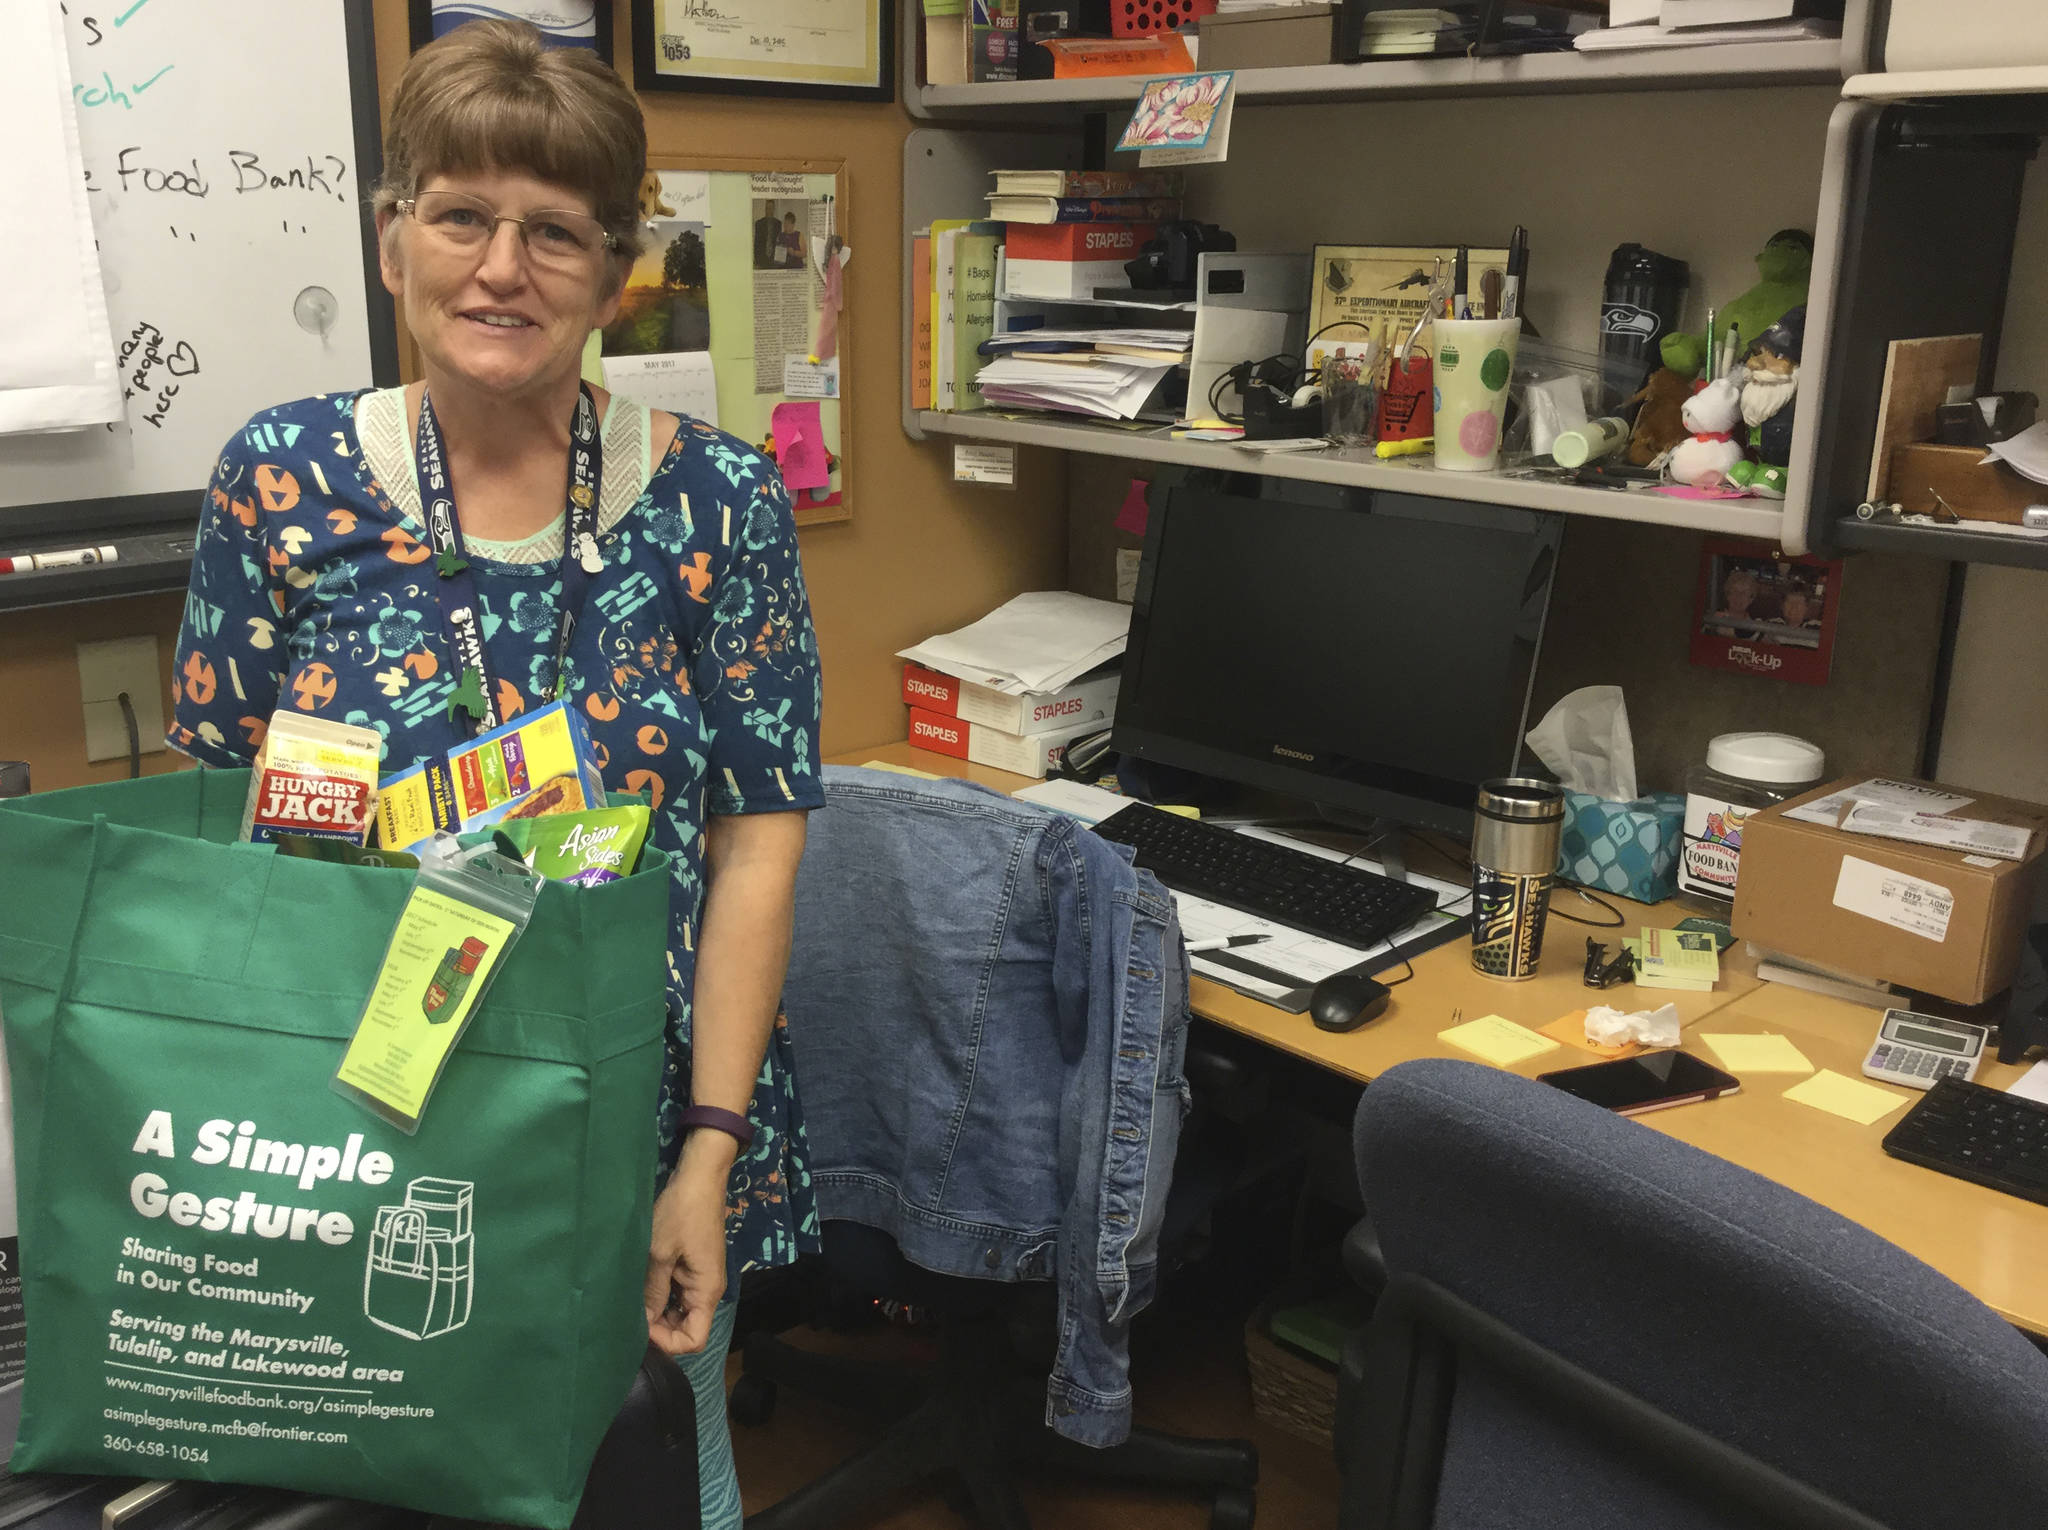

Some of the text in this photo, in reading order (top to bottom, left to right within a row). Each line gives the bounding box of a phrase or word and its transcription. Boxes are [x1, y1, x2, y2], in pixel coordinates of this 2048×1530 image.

[662, 45, 691, 61] 1053
[118, 147, 209, 198] Food
[229, 150, 345, 202] Bank?
[1085, 232, 1134, 249] STAPLES
[644, 361, 659, 369] MAY
[907, 679, 949, 702] STAPLES
[1033, 698, 1083, 722] STAPLES
[346, 738, 366, 748] Open
[914, 721, 959, 744] STAPLES
[273, 761, 294, 771] 100%
[1273, 744, 1314, 761] lenovo
[269, 775, 362, 799] HUNGRY
[430, 765, 449, 829] VARIETY PACK
[261, 792, 362, 825] JACK
[384, 796, 397, 844] BREAKFAST
[558, 823, 620, 857] Asian
[1696, 843, 1737, 860] MARYSVILLE
[579, 845, 624, 871] Sides
[1688, 850, 1738, 873] FOOD BAN
[1520, 879, 1540, 974] SEAHAWKS
[132, 1109, 395, 1190] A Simple
[130, 1172, 354, 1245] Gesture
[121, 1236, 260, 1277] Sharing Food
[116, 1263, 316, 1314] in Our Community
[109, 1309, 351, 1358] Serving the Marysville,
[108, 1333, 404, 1382] Tulalip, and Lakewood area
[105, 1375, 435, 1420] www.marysvillefoodbank.org/asimplegesture
[103, 1406, 348, 1444] asimplegesture.mcfb@frontier.com
[103, 1434, 210, 1464] 360-658-1054
